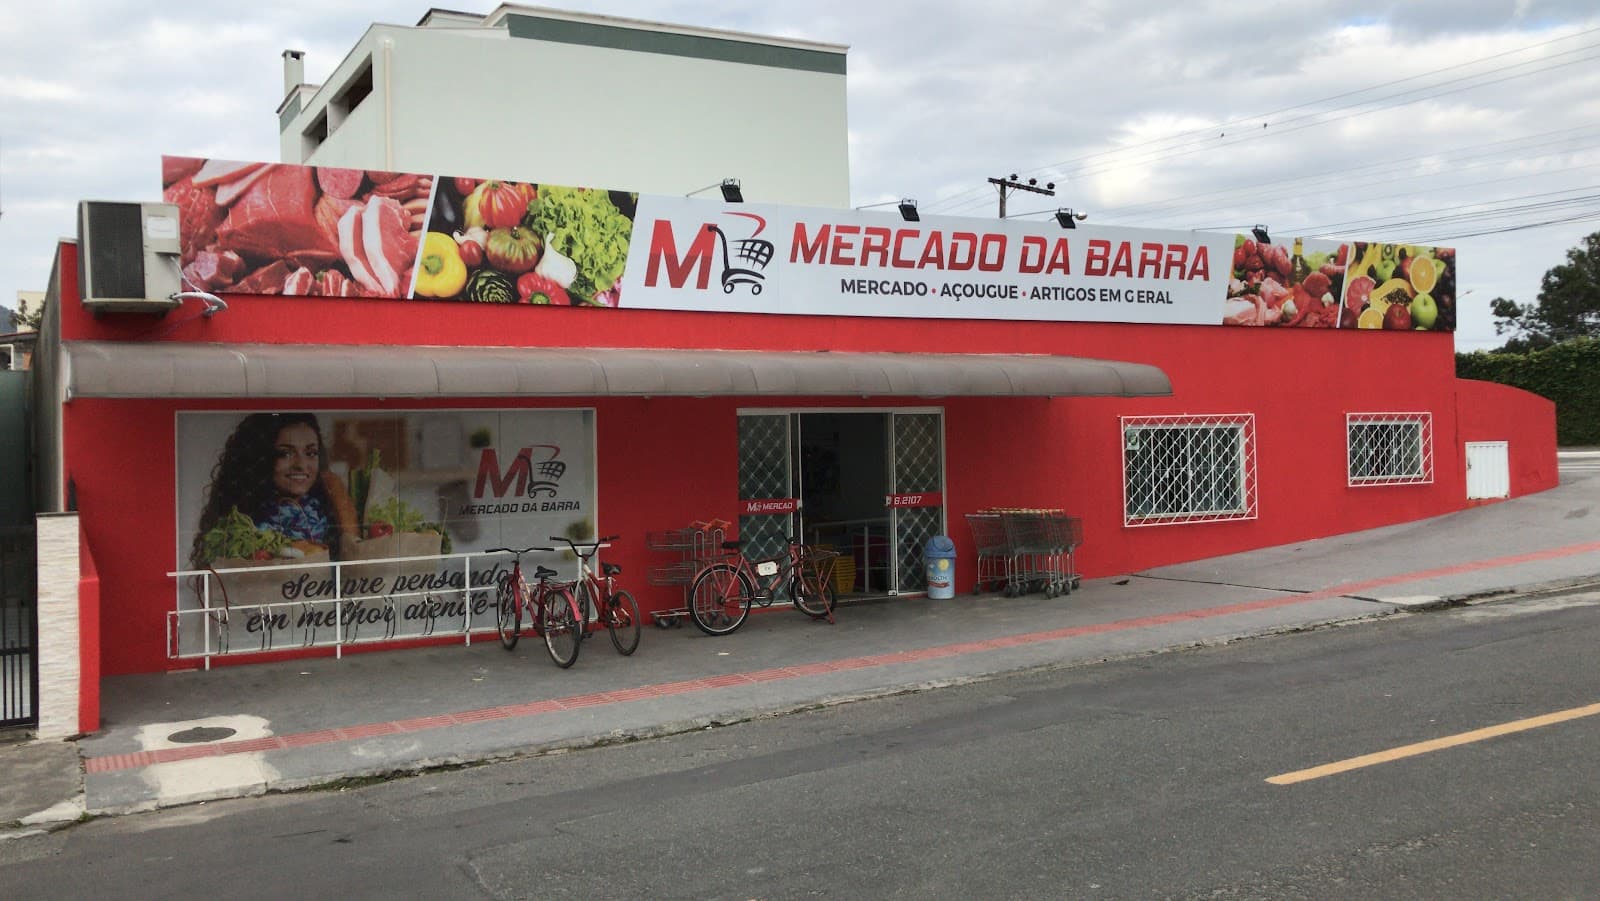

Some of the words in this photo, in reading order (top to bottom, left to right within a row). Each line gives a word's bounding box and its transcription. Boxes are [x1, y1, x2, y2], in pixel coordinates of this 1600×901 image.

[790, 222, 1008, 273] MERCADO
[1018, 235, 1071, 275] DA
[1084, 239, 1210, 281] BARRA
[841, 279, 928, 297] MERCADO
[940, 283, 1018, 301] AÇOUGUE
[1030, 286, 1096, 302] ARTIGOS
[1100, 289, 1121, 302] EM
[1125, 289, 1173, 304] GERAL
[458, 503, 519, 516] MERCADO
[521, 502, 537, 513] DA
[541, 501, 580, 512] BARRA
[282, 573, 386, 601] Sempre
